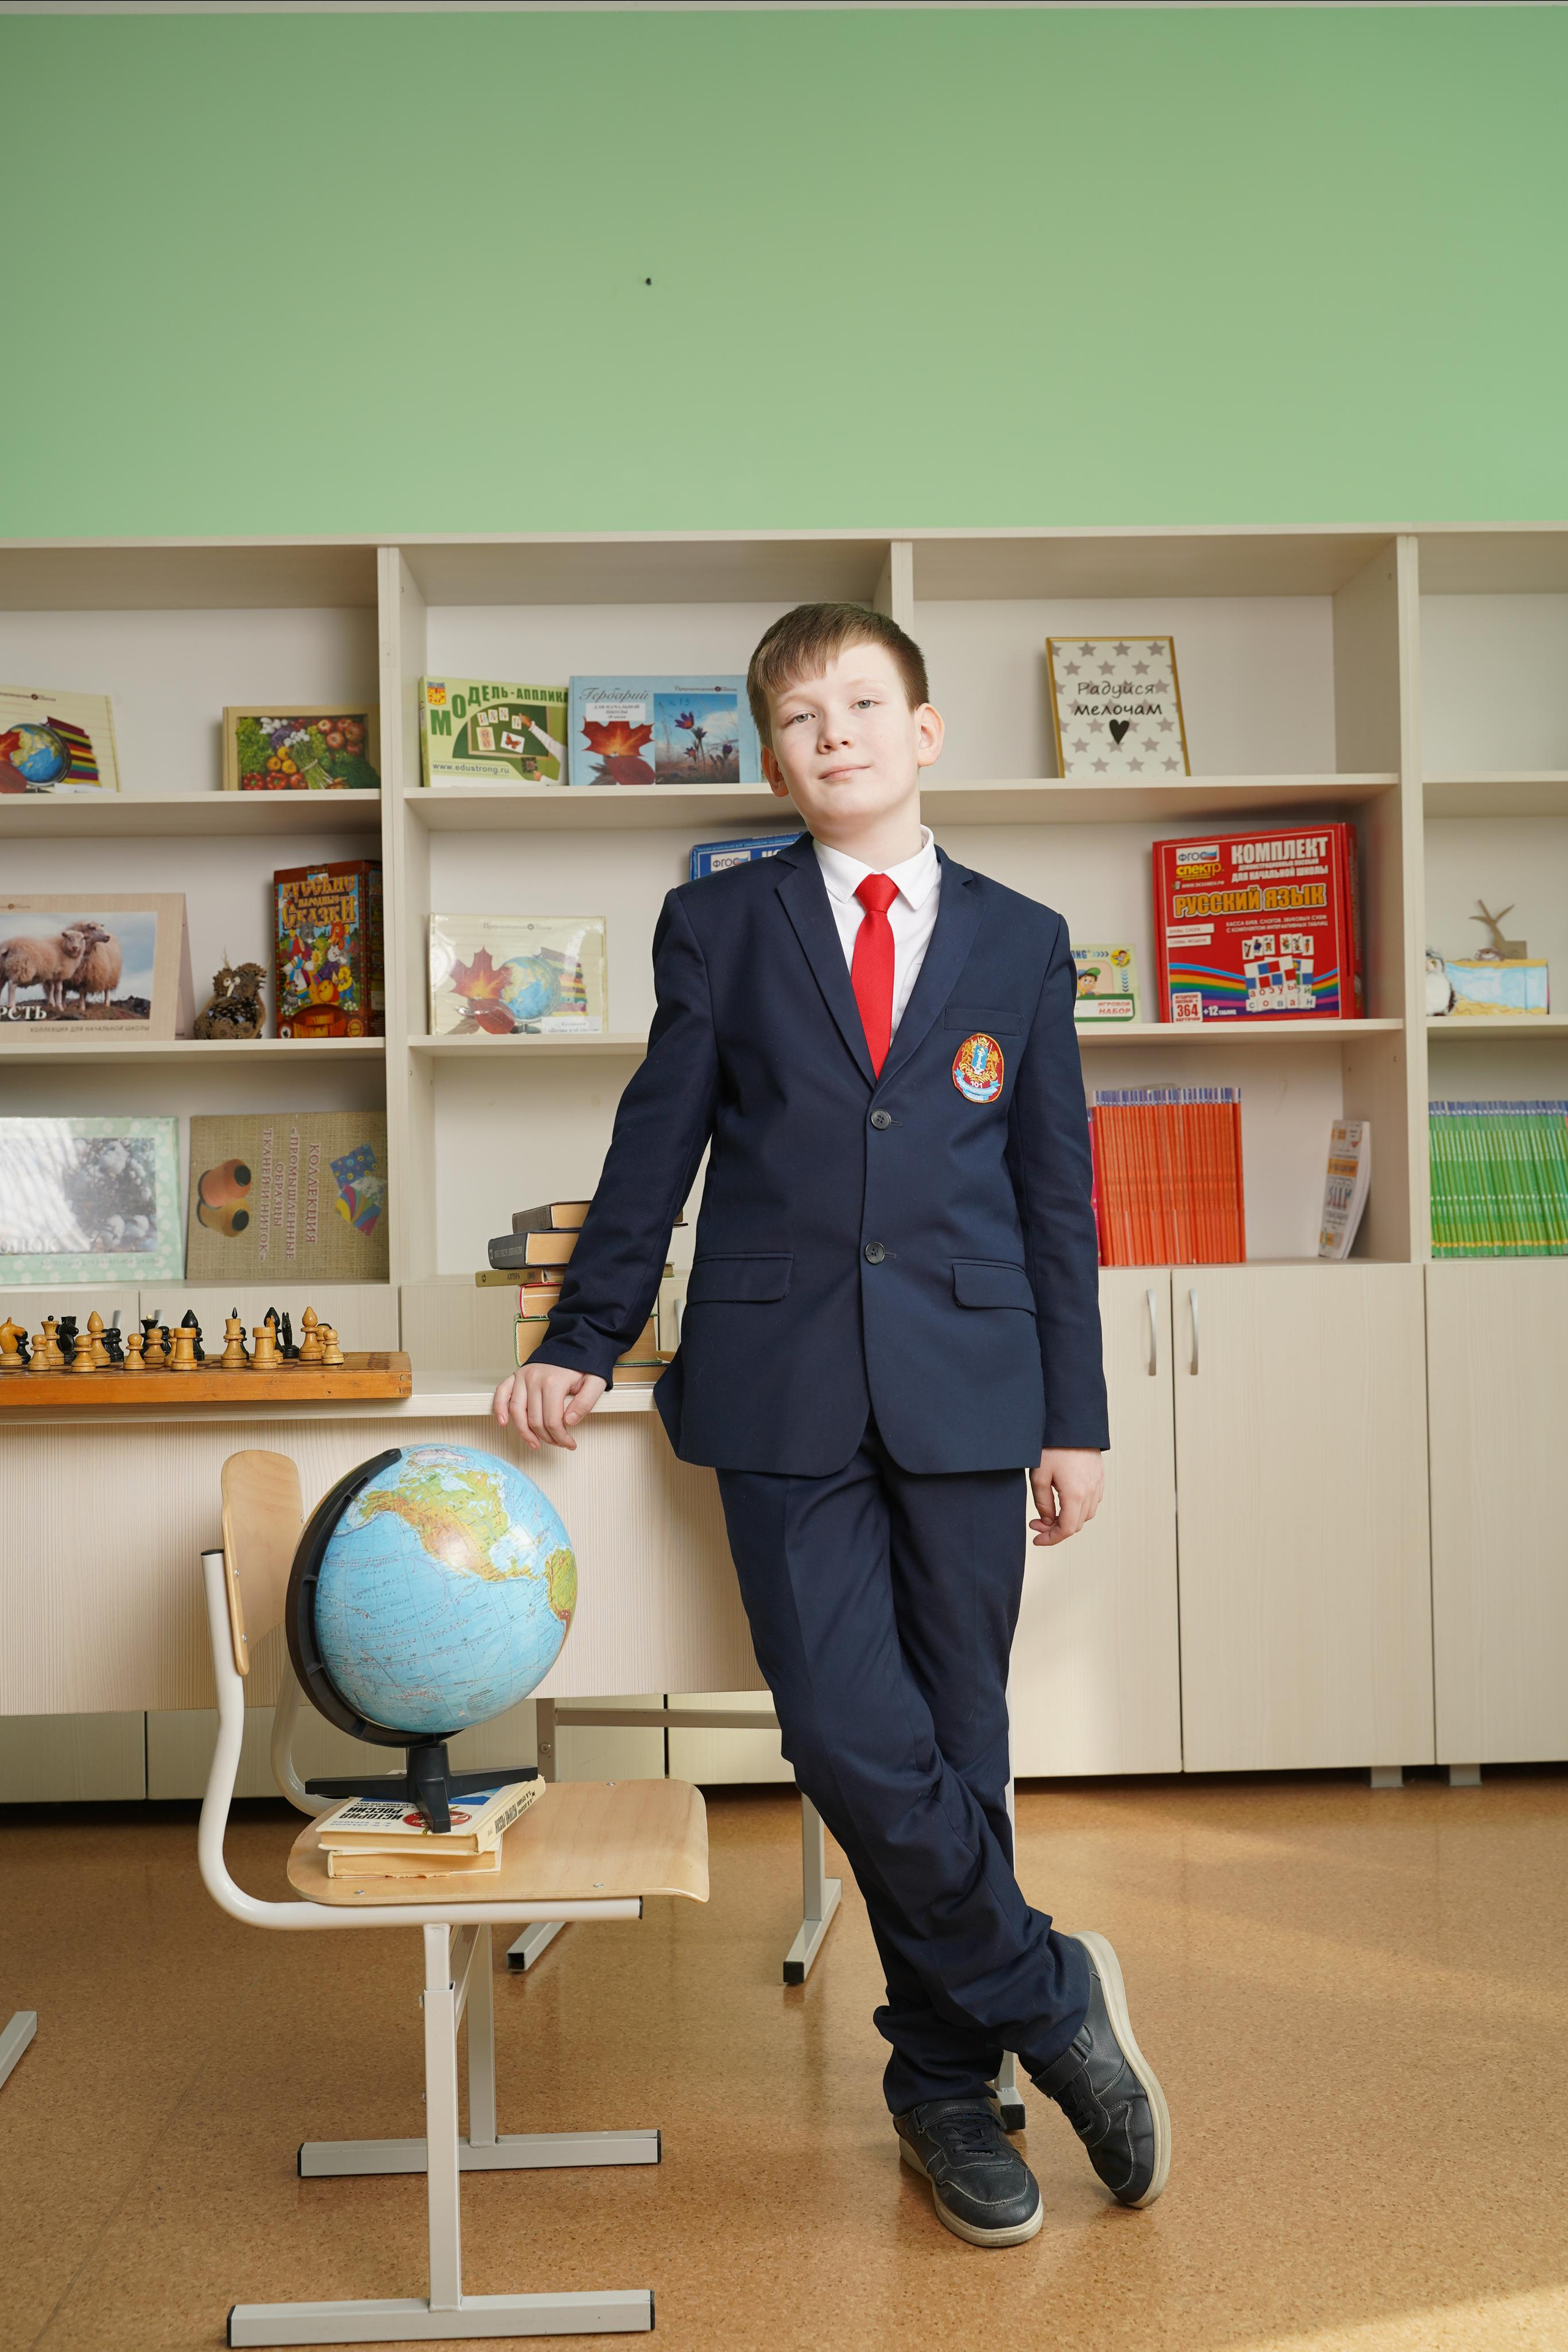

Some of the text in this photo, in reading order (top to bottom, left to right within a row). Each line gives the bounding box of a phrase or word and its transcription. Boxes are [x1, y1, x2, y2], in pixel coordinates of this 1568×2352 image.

[579, 687, 649, 703] Гербарий
[1078, 680, 1154, 699] Радуйся
[1074, 704, 1162, 716] мелочам
[432, 763, 510, 775] www.edustrong.ru
[1178, 852, 1208, 862] ФГОС
[1231, 837, 1329, 865] КОМПЛЕКТ
[1249, 868, 1295, 881] НАЧАЛЬНОЙ
[1296, 865, 1329, 876] ШКОЛЫ
[1175, 884, 1325, 918] РУССКИЙ ЯЗЫК
[1177, 1004, 1199, 1017] 364
[260, 1129, 272, 1261] ТКАНЕЙ И НИТОК»
[274, 1163, 284, 1227] ОБРАЗЦЫ
[286, 1128, 299, 1260] «ПРОМЫШЛЕННЫЕ
[306, 1144, 320, 1243] КОЛЛЕКЦИЯ
